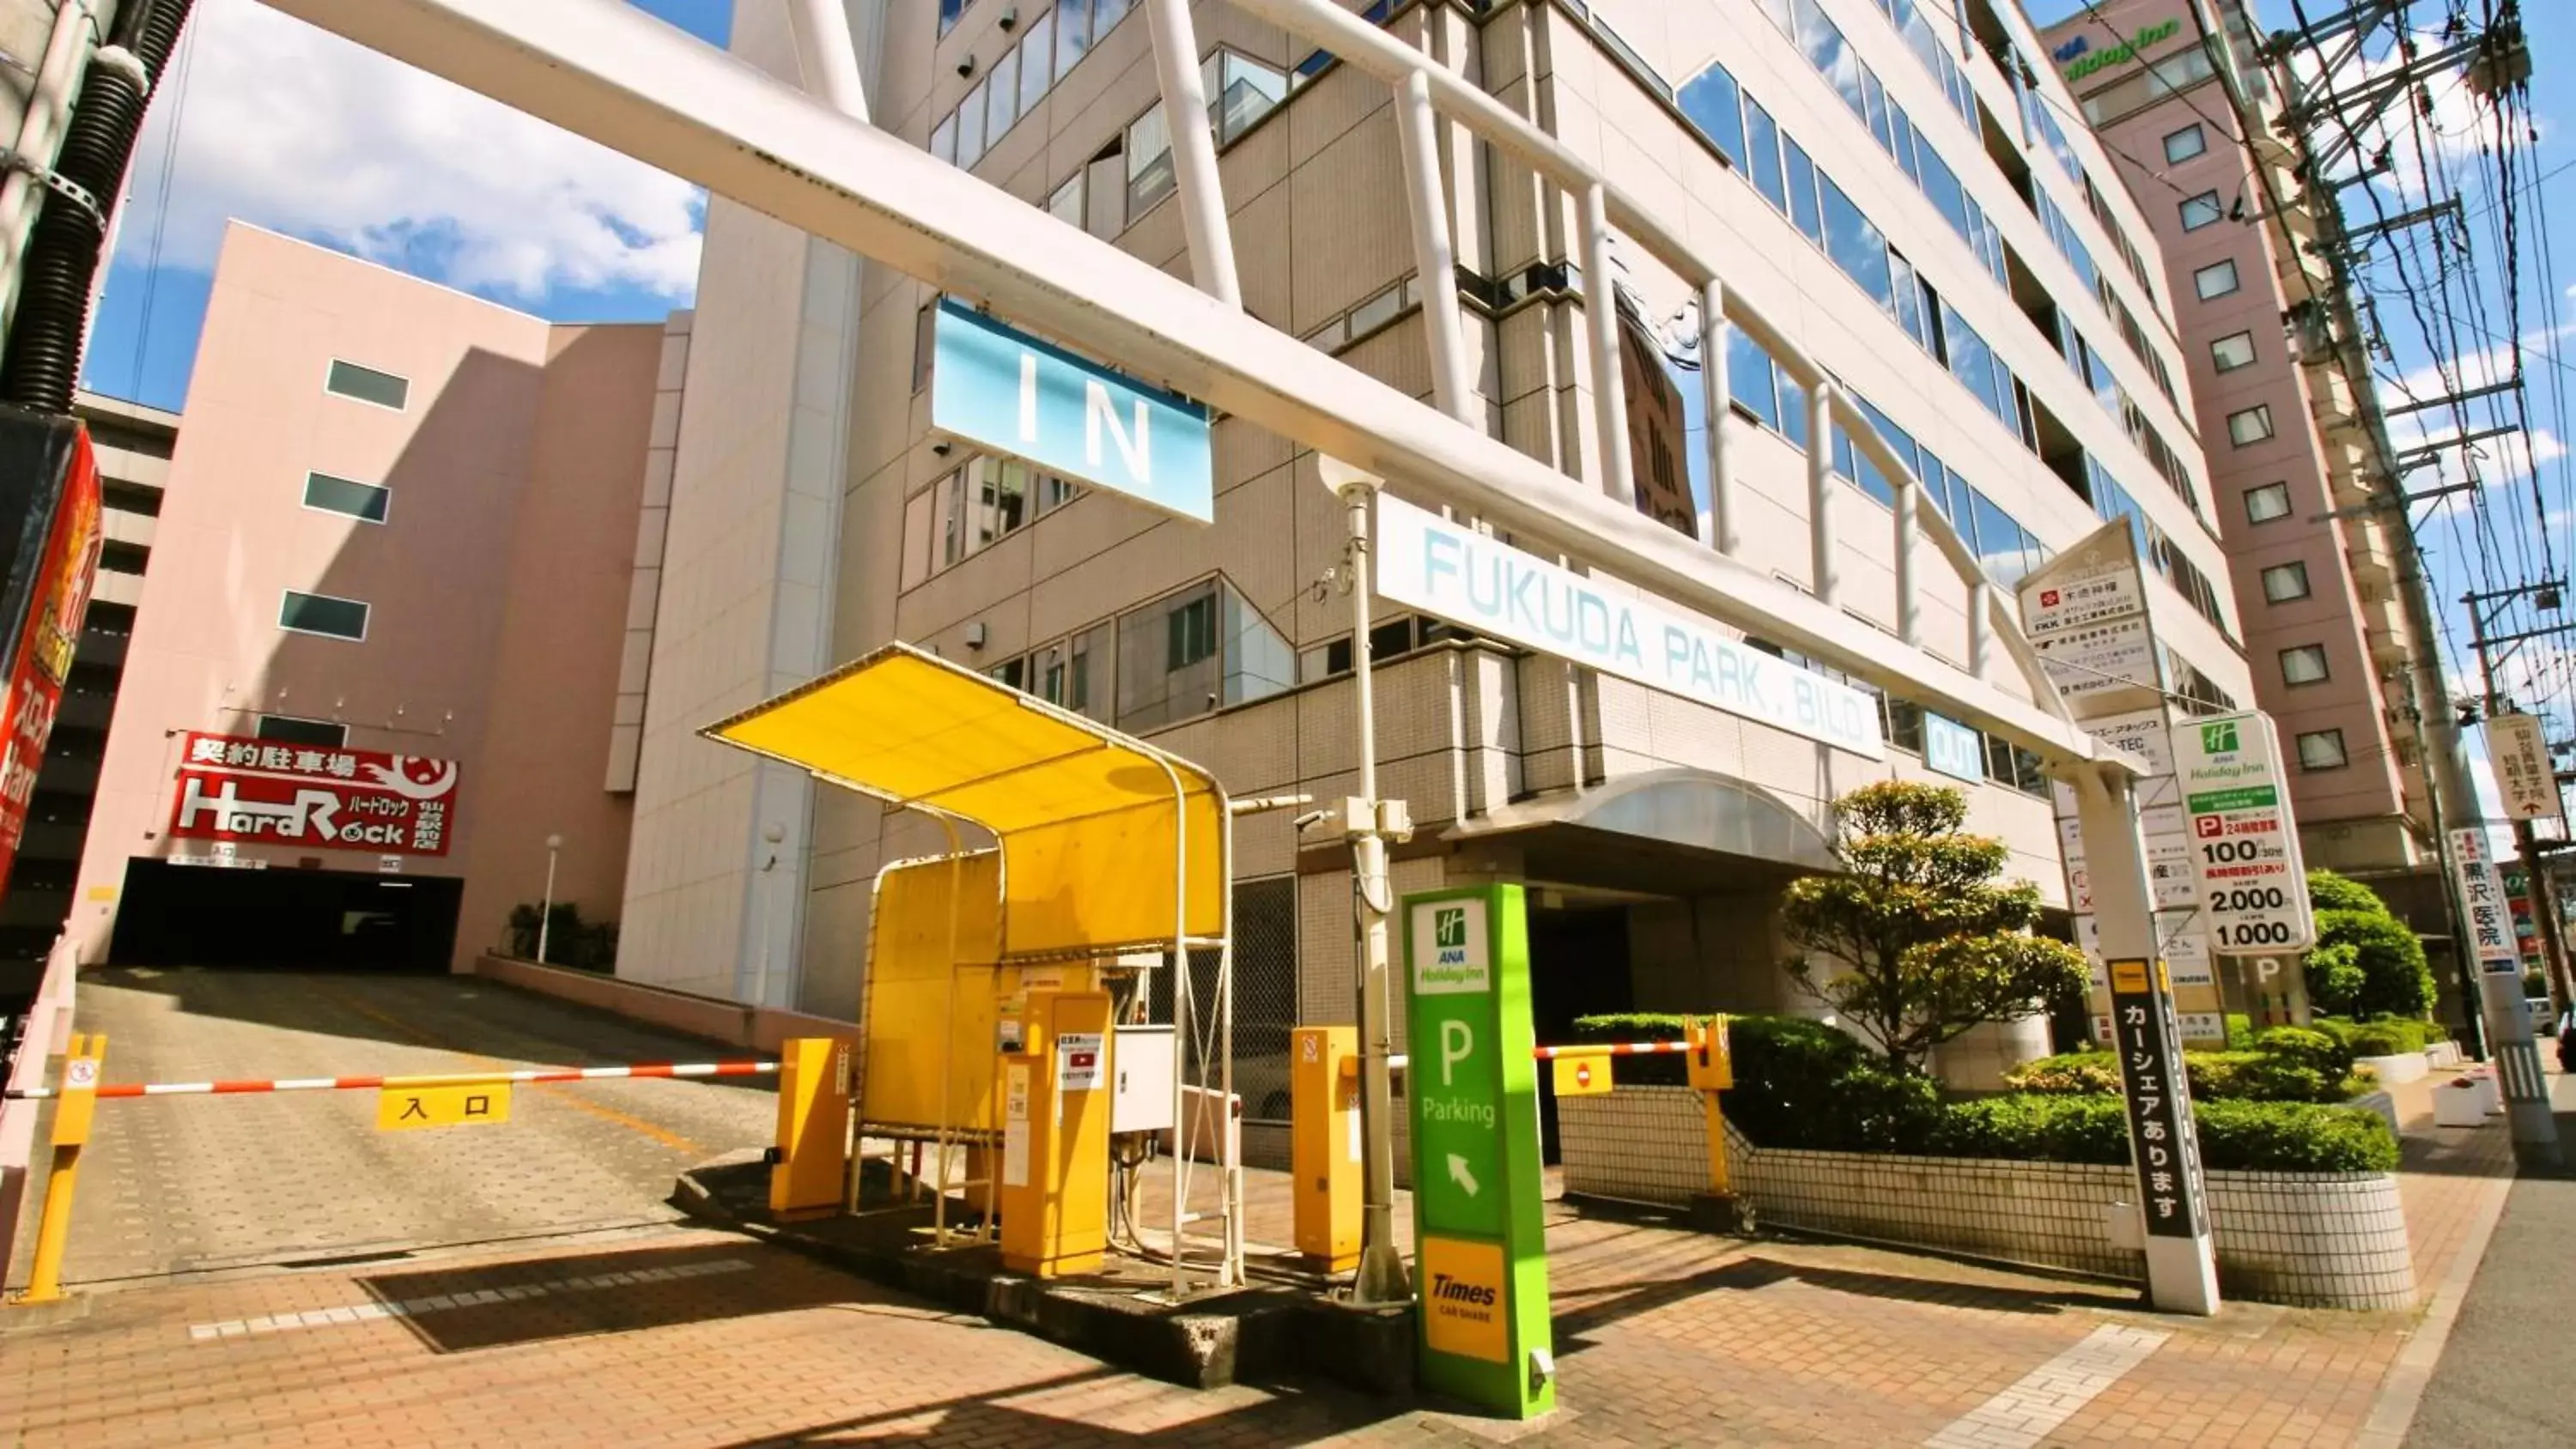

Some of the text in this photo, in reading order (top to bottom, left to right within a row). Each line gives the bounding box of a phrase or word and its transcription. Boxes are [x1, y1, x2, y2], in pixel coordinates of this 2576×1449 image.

[1019, 352, 1151, 484] IN
[1425, 526, 1643, 670] FUKUDA
[2035, 619, 2060, 632] FKK
[191, 739, 357, 778] 契約駐車場
[2242, 763, 2264, 773] Inn
[349, 796, 410, 816] ハードロック
[2202, 840, 2257, 864] 100
[2464, 862, 2501, 948] 黒沢医院
[1438, 950, 1465, 964] ANA
[2257, 957, 2281, 984] P
[1421, 967, 1485, 983] Holiday Inn
[1440, 1019, 1474, 1087] P
[399, 1094, 489, 1120] 入口
[1422, 1097, 1496, 1130] Parking
[2124, 1004, 2178, 1218] カーシェアあります
[1432, 1273, 1497, 1307] Times
[1439, 1303, 1492, 1324] CAR SHARE
